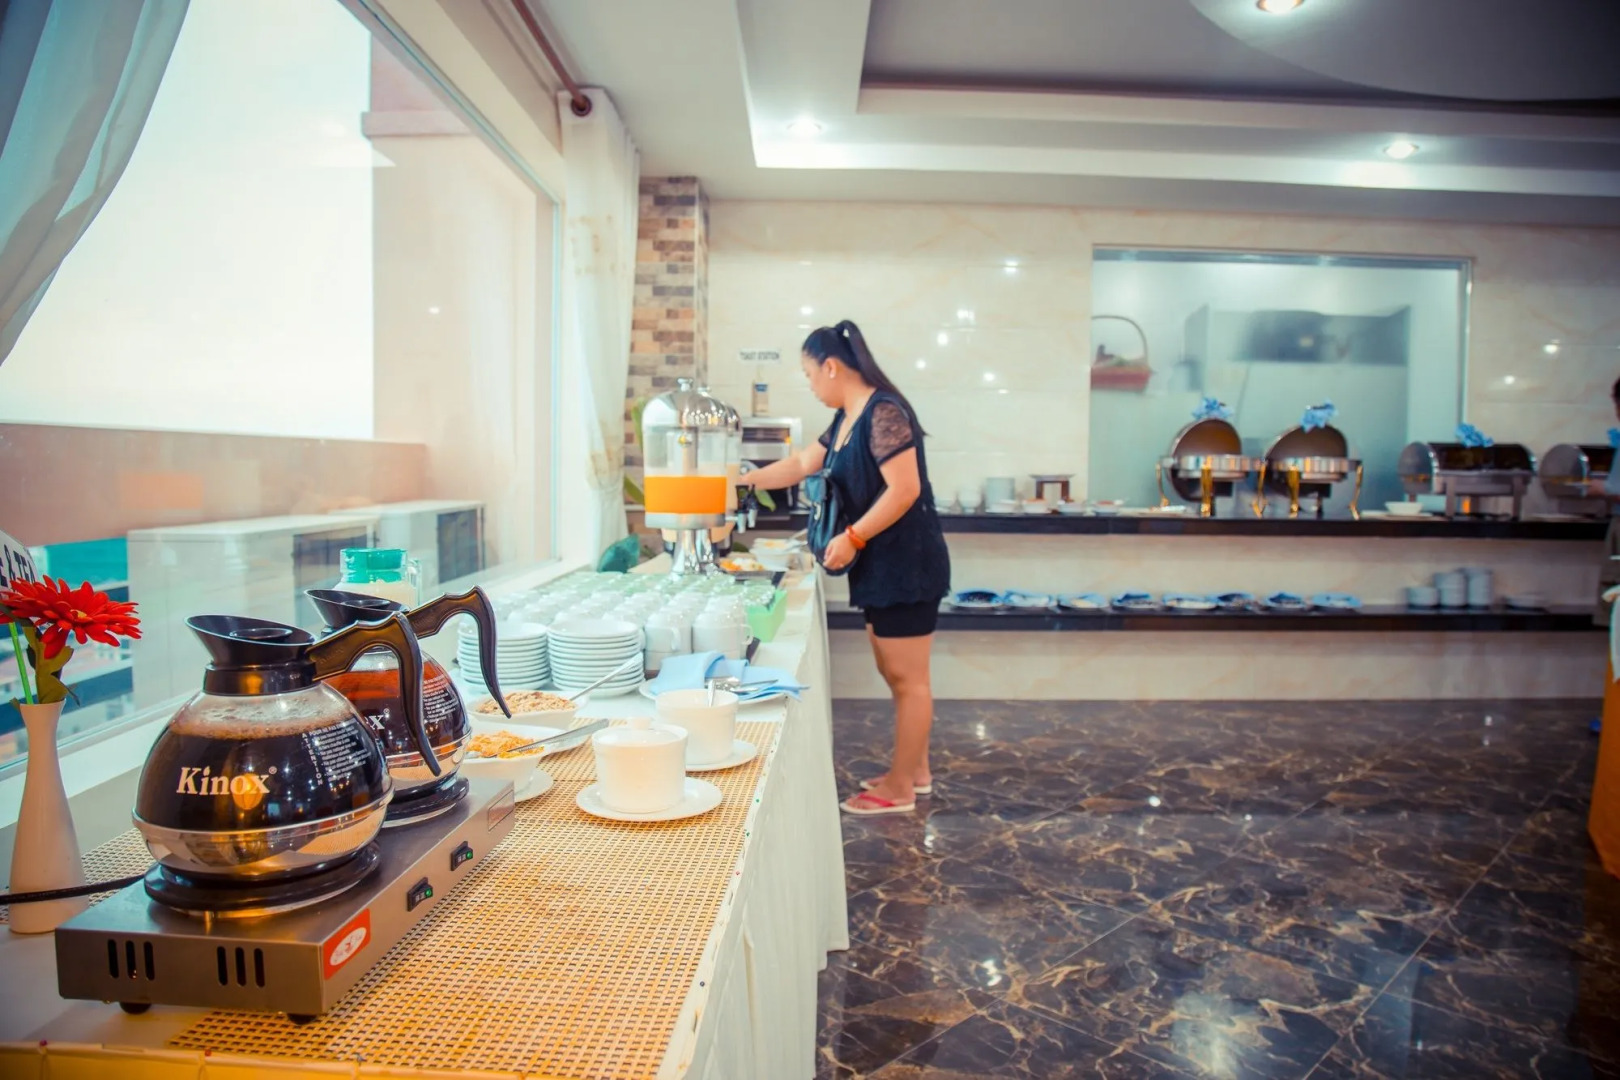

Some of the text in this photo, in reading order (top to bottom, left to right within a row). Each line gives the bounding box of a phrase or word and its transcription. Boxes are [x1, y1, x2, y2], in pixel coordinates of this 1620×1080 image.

[13, 550, 36, 585] TEA
[302, 732, 323, 786] ATTENTION
[176, 766, 270, 795] Kinox
